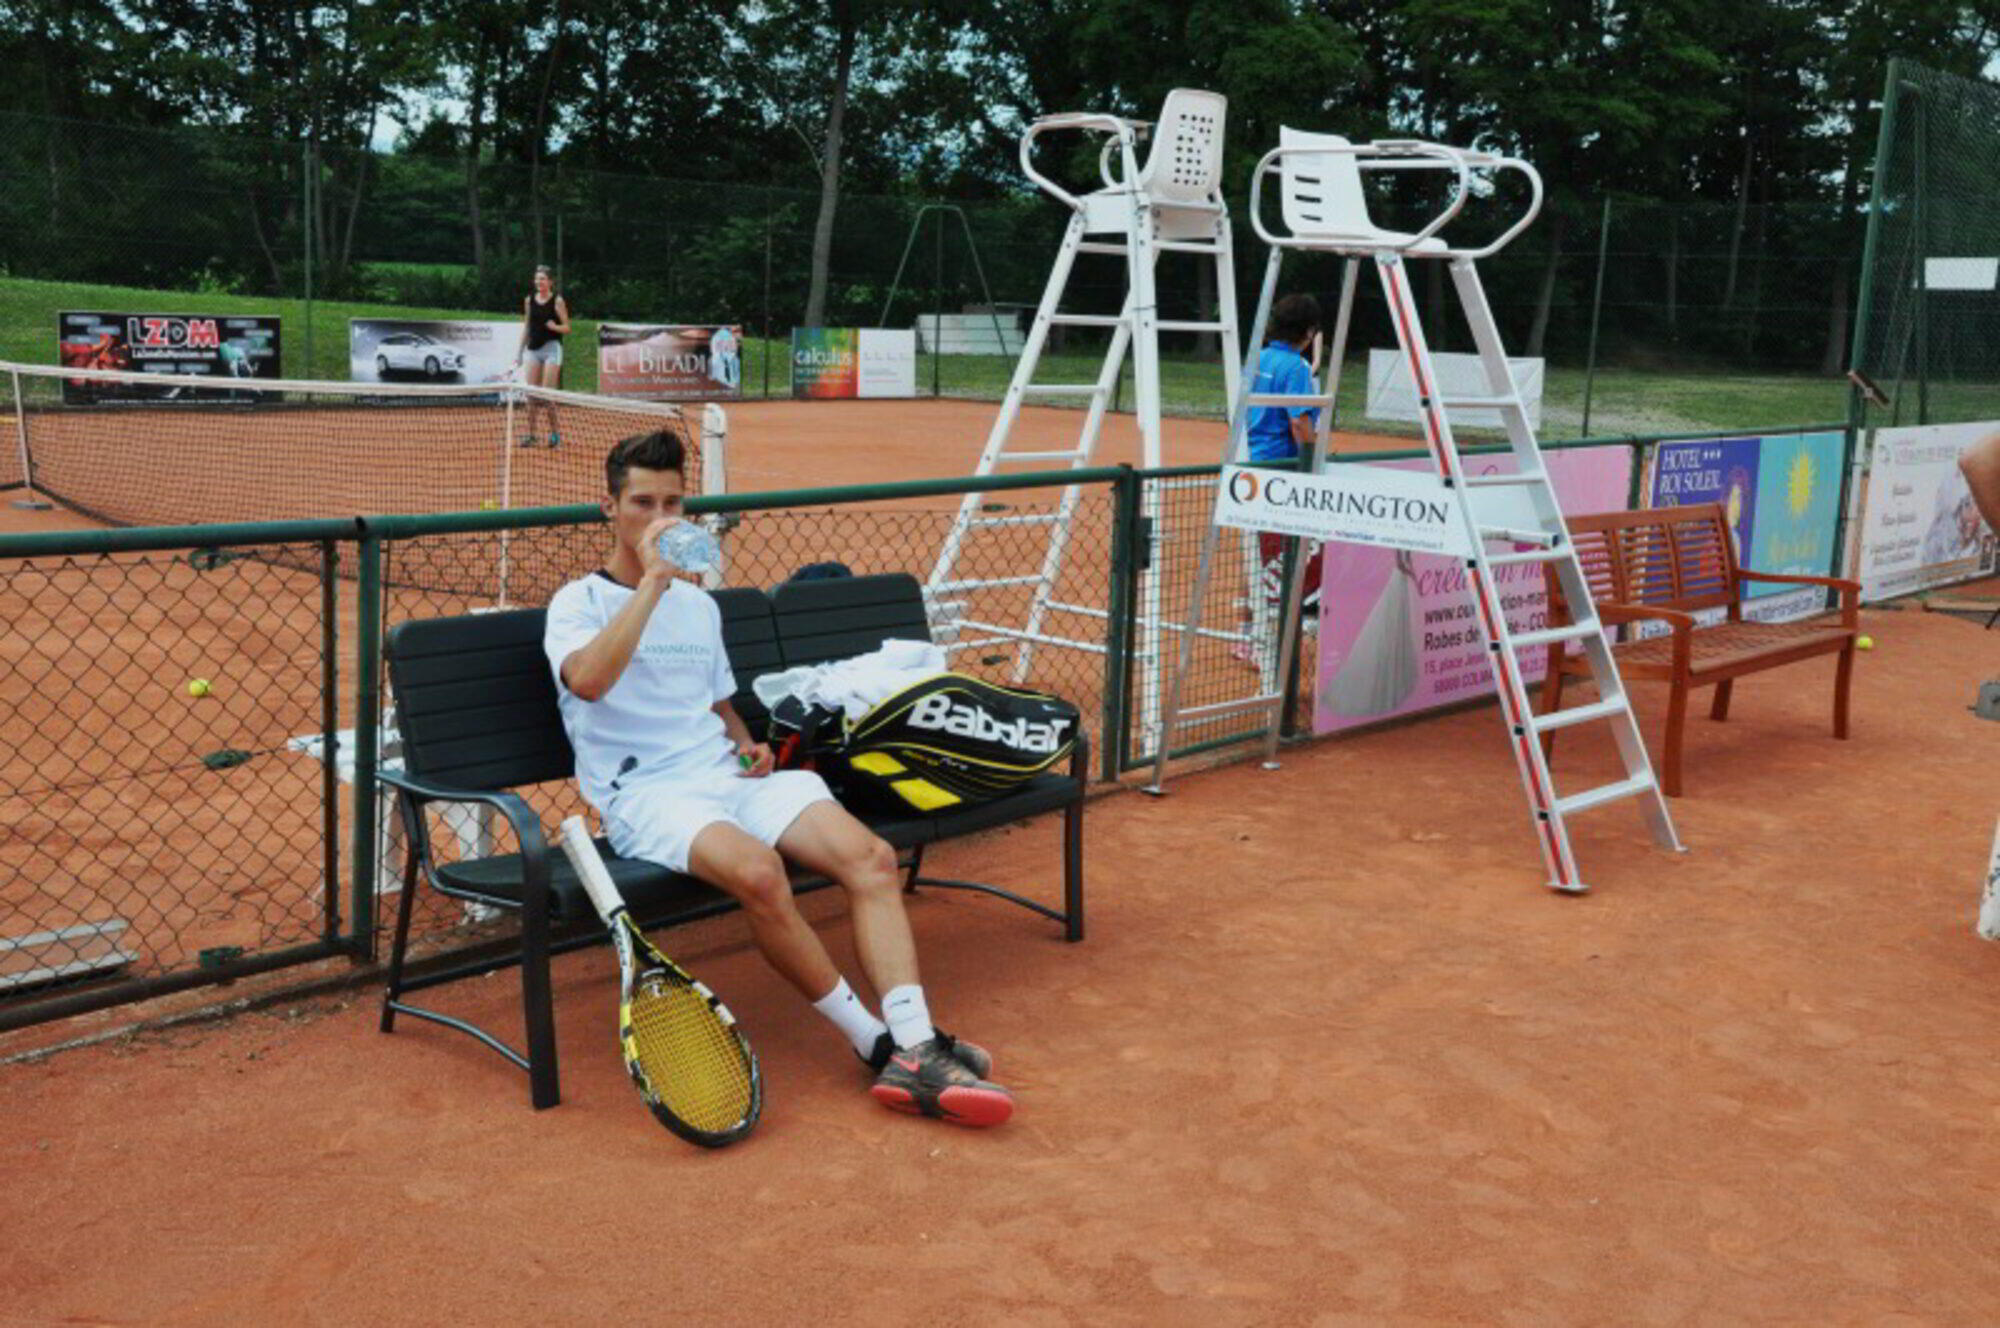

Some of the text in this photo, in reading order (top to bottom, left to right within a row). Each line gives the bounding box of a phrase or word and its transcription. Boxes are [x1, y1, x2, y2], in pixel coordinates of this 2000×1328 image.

[126, 316, 219, 348] LZDM
[1264, 476, 1449, 525] CARRINGTON
[906, 693, 1071, 754] Babolat
